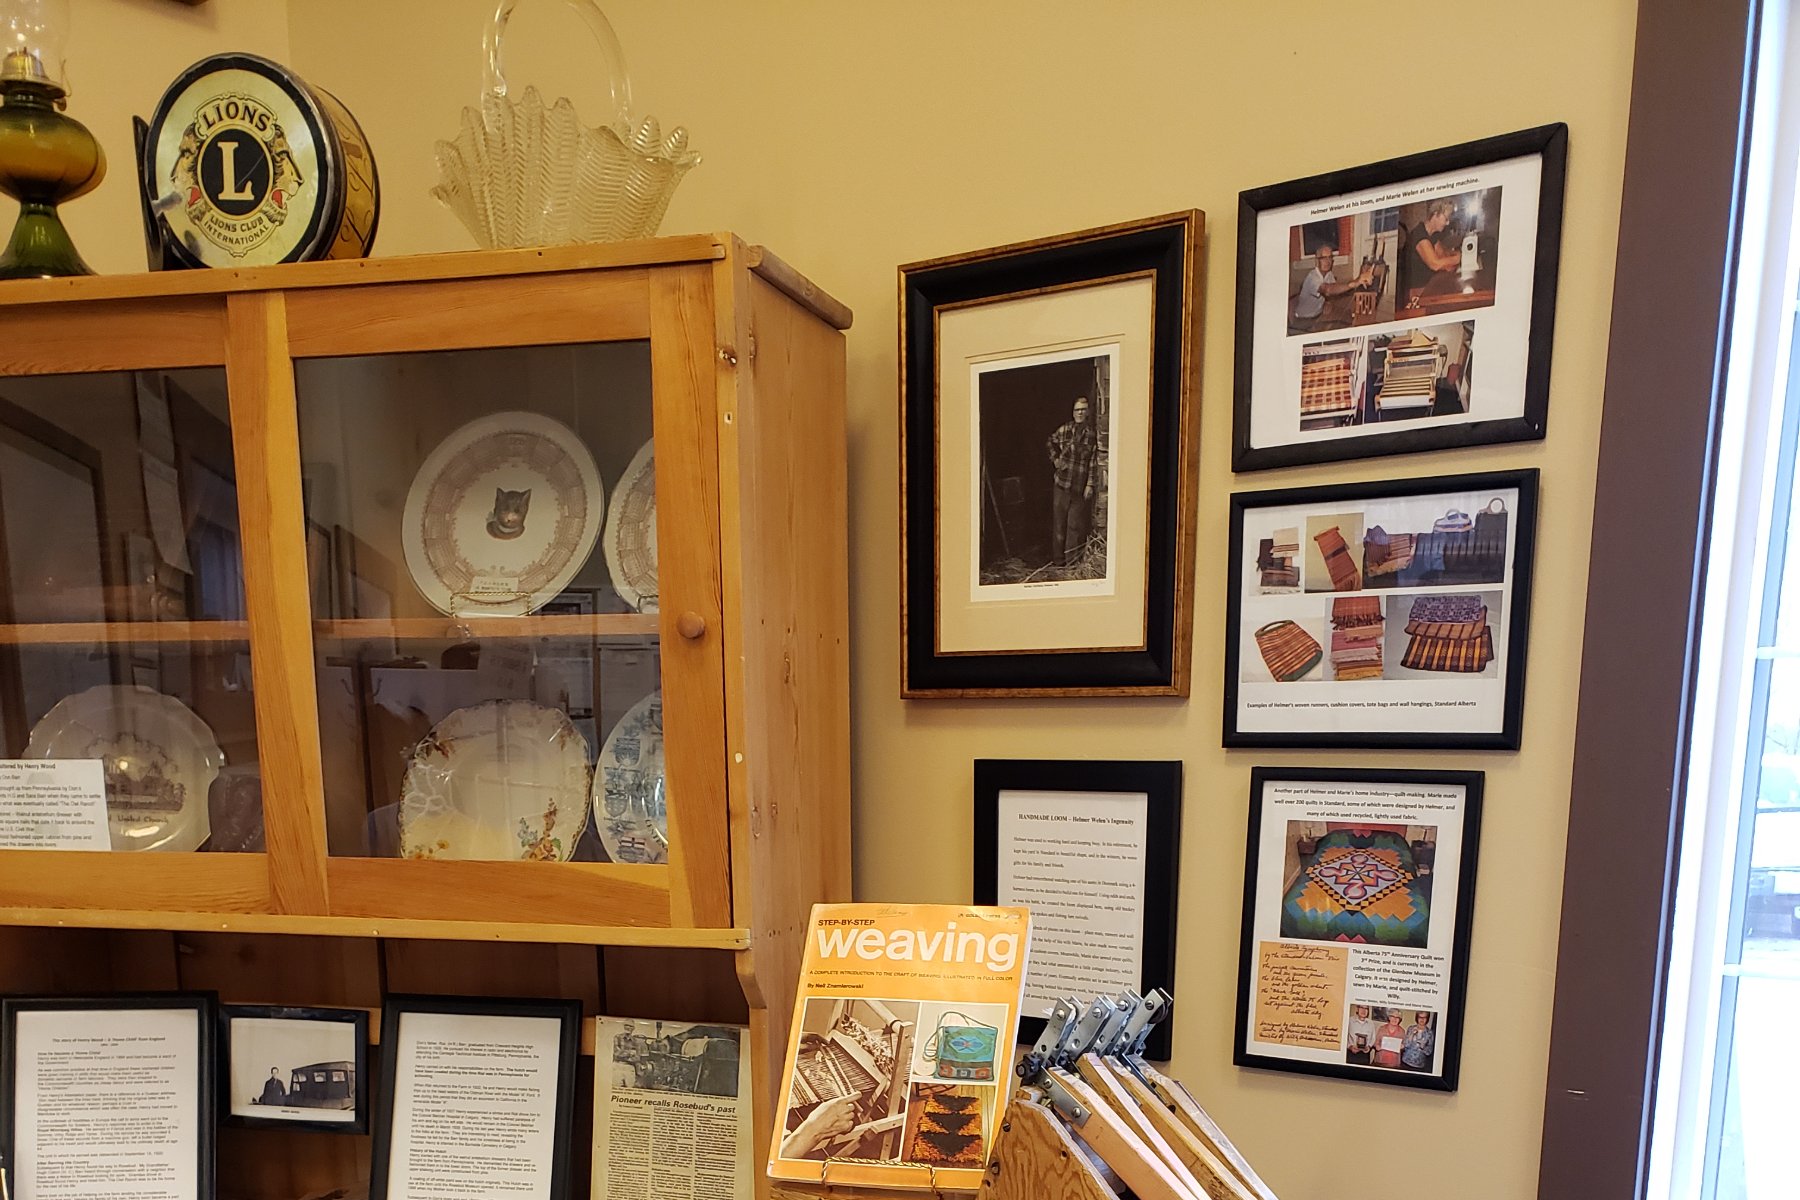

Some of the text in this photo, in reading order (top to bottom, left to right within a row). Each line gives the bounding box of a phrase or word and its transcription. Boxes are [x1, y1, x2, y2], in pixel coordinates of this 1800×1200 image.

[203, 102, 270, 131] LIONS
[217, 142, 254, 200] L
[1375, 195, 1385, 203] and
[1386, 192, 1401, 201] Marie
[1436, 183, 1455, 191] sewing
[204, 220, 269, 245] INTERNATIONAL
[211, 215, 263, 232] LIONS CLUB
[1111, 818, 1134, 826] Ingenuity
[816, 922, 1018, 972] weaving
[1391, 952, 1419, 960] Anniversary
[611, 1095, 642, 1105] Pioneer
[644, 1099, 670, 1107] recalls
[673, 1101, 714, 1111] Rosebud's
